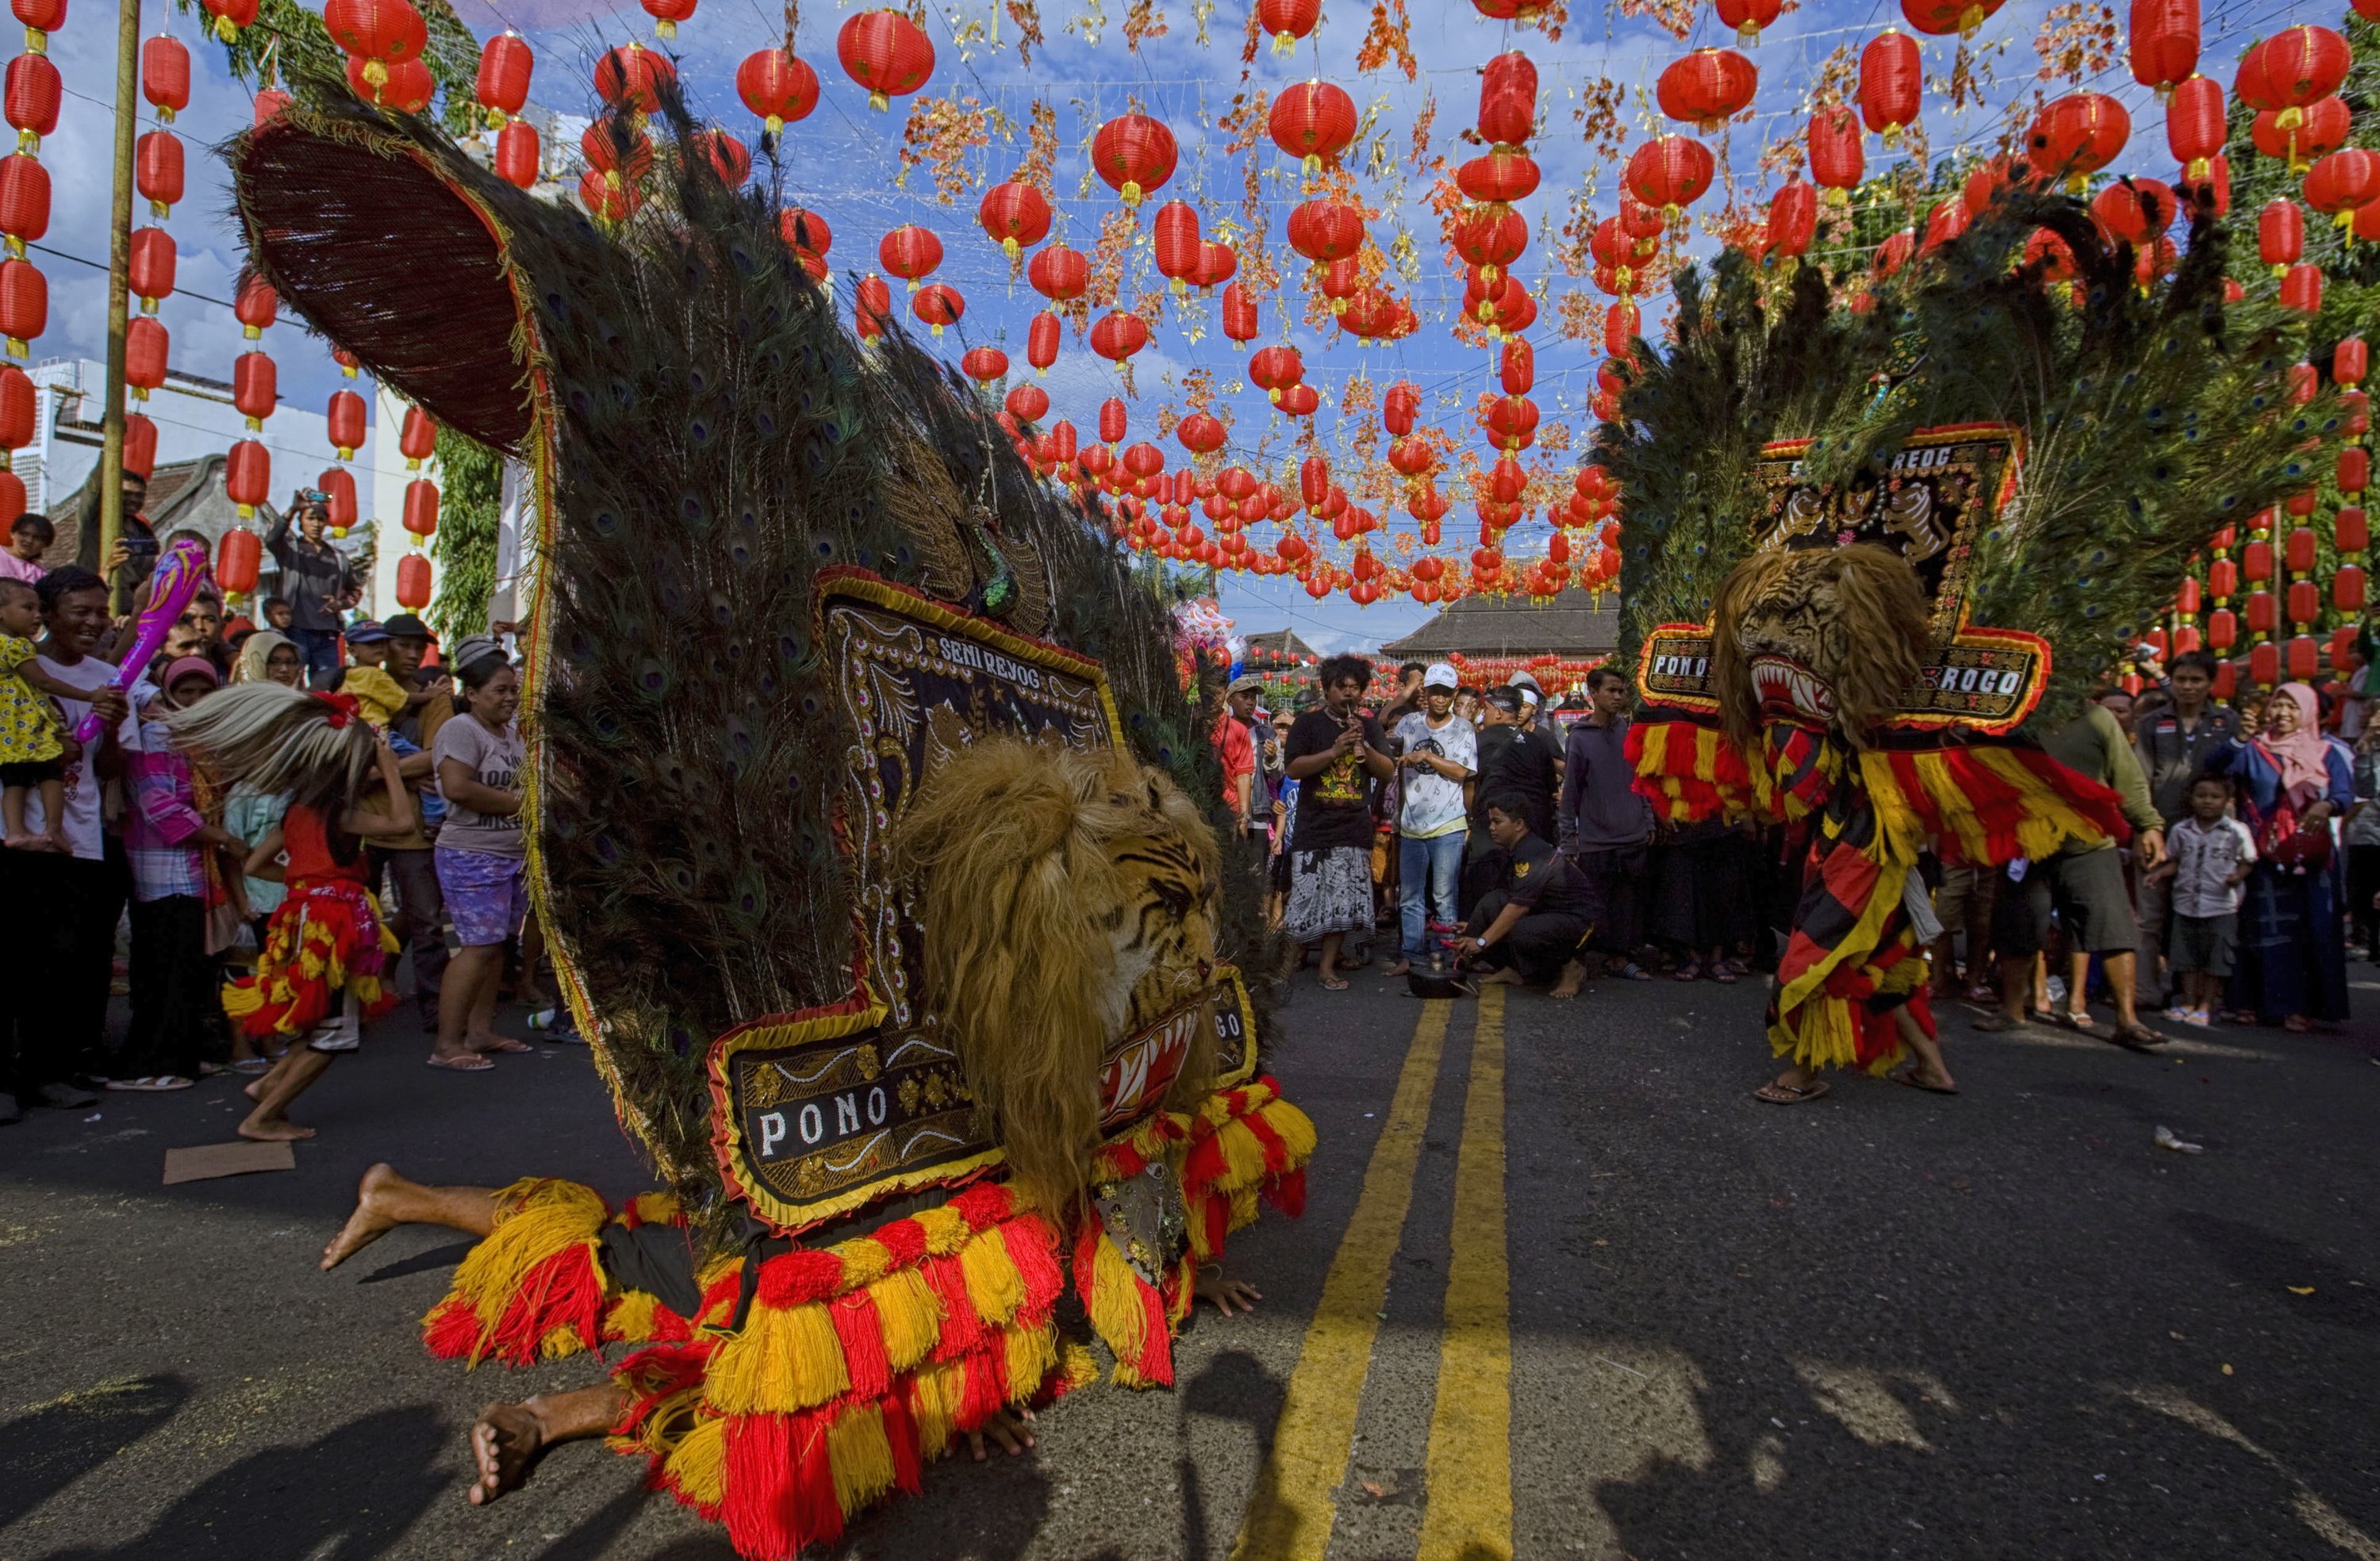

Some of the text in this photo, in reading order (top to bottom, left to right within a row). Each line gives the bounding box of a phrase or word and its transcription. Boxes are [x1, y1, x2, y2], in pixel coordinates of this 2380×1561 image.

[1891, 447, 1951, 470] REOG
[939, 637, 1040, 688] SENI REYOG
[1654, 656, 1707, 677] PONO
[1940, 667, 2020, 694] ROGO
[759, 1086, 887, 1156] PONO
